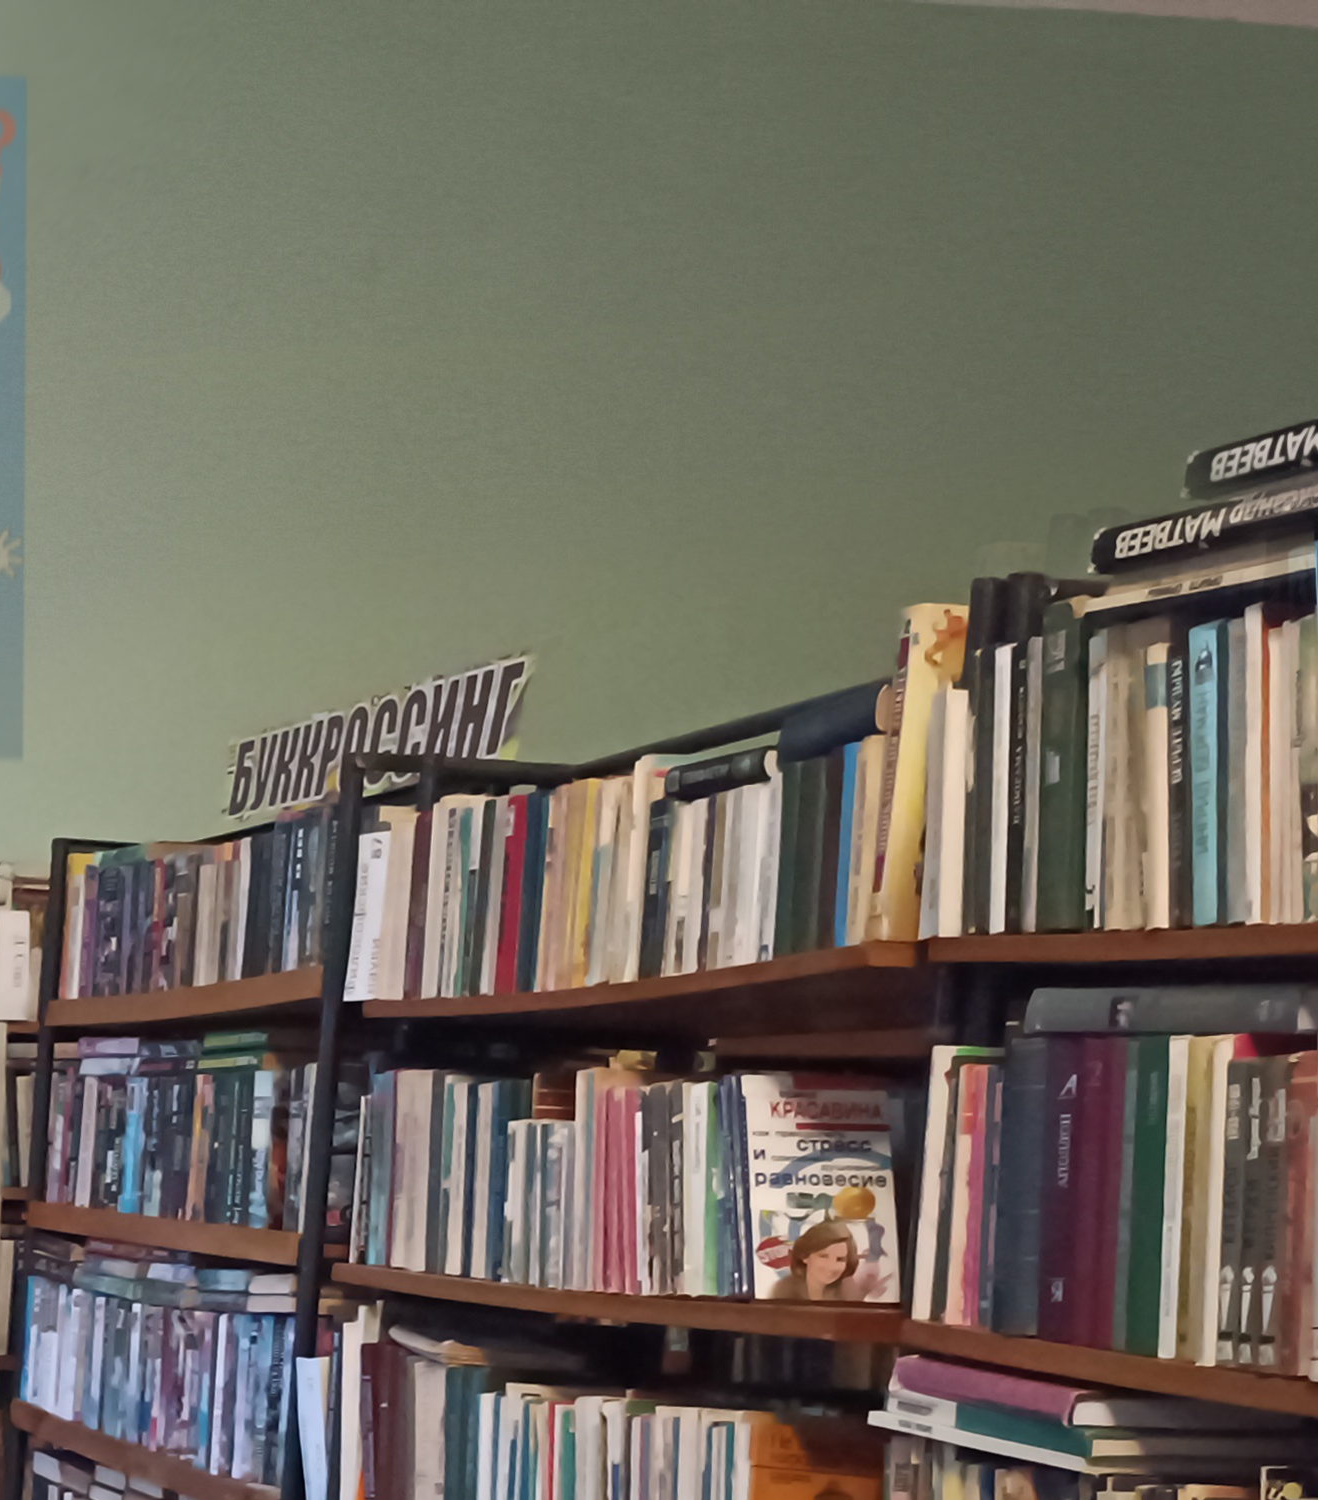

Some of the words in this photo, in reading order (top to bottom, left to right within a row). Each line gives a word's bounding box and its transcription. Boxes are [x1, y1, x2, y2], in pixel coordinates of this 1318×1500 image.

[1114, 507, 1229, 560] МАТВЕЕВ
[227, 659, 528, 817] БУККРОССИНГ
[769, 1100, 885, 1122] КРАСАВИНА
[796, 1137, 873, 1156] стресс
[753, 1170, 888, 1189] равновесие
